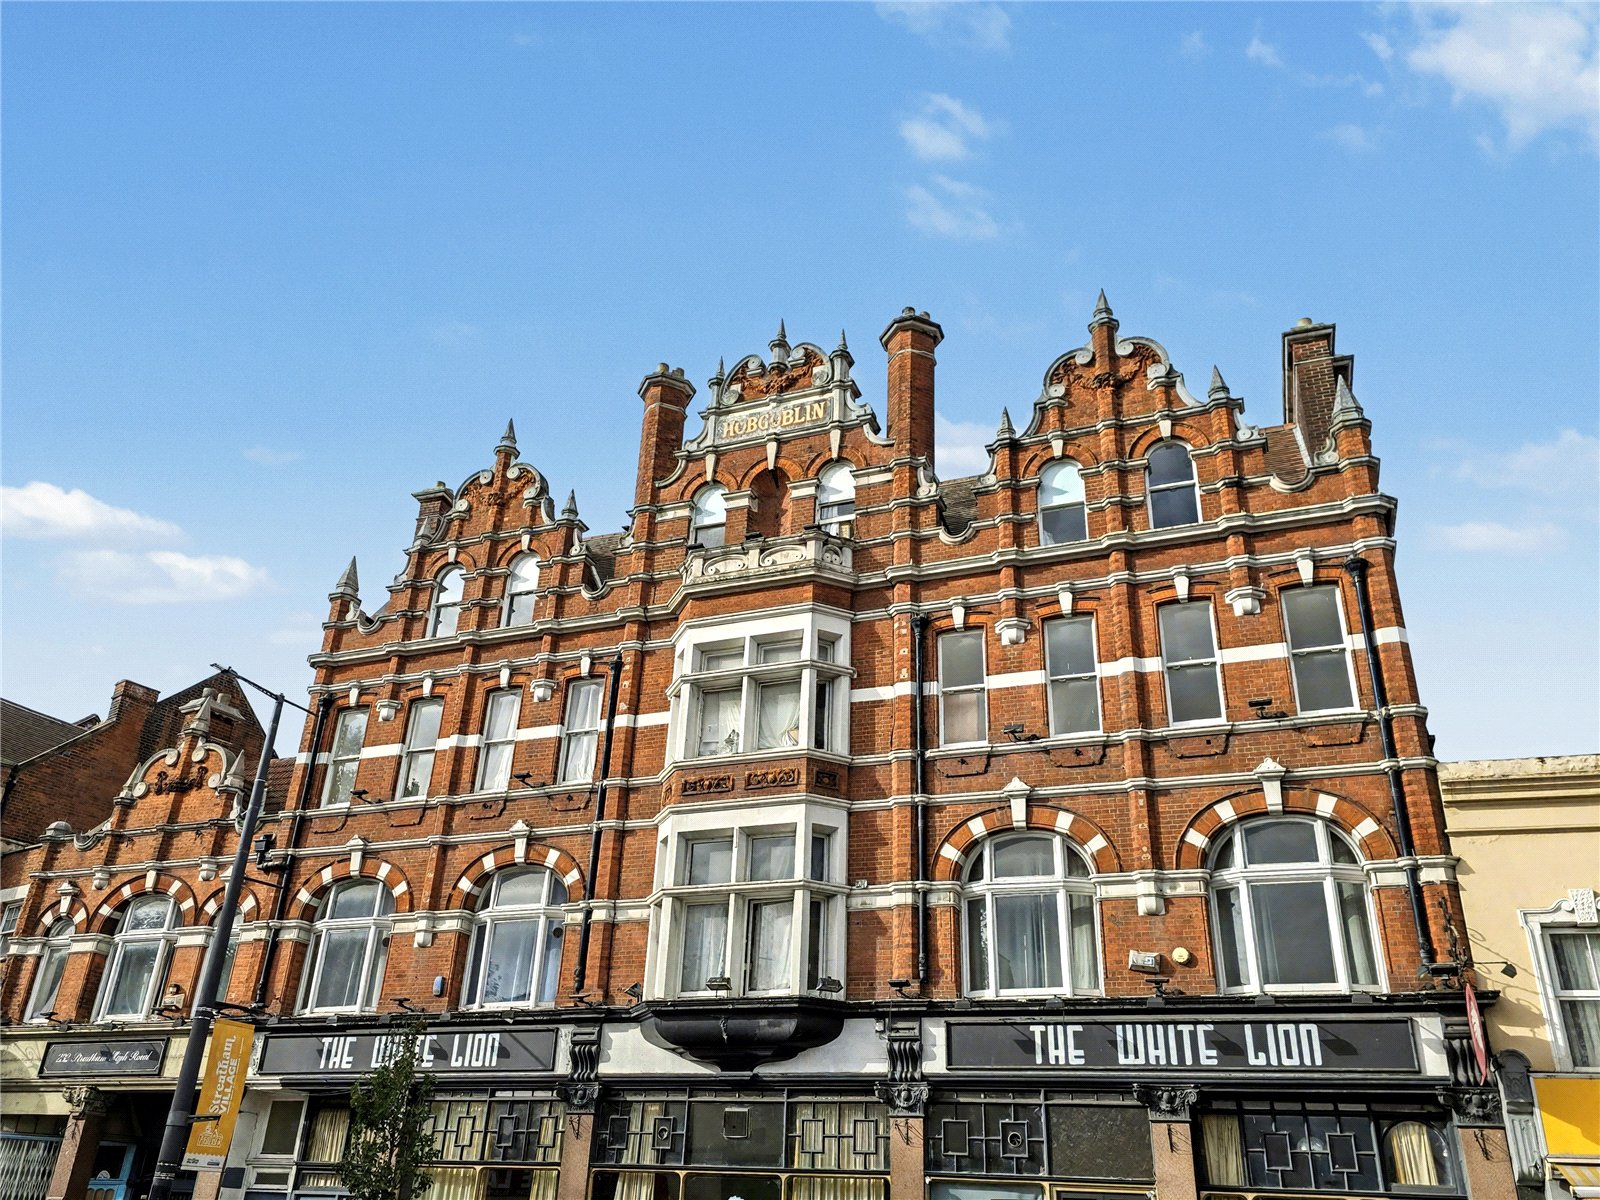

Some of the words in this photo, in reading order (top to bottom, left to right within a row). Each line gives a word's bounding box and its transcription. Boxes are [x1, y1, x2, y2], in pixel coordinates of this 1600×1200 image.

[722, 401, 826, 438] HOBGOBLIN
[128, 1050, 153, 1061] Road
[319, 1036, 357, 1069] THE
[371, 1034, 438, 1068] WHTE
[450, 1033, 500, 1067] LION
[1029, 1024, 1085, 1065] THE
[1115, 1024, 1218, 1065] WHITE
[1244, 1023, 1322, 1066] LION
[209, 1035, 237, 1114] Streatham
[218, 1059, 238, 1115] VILLAGE
